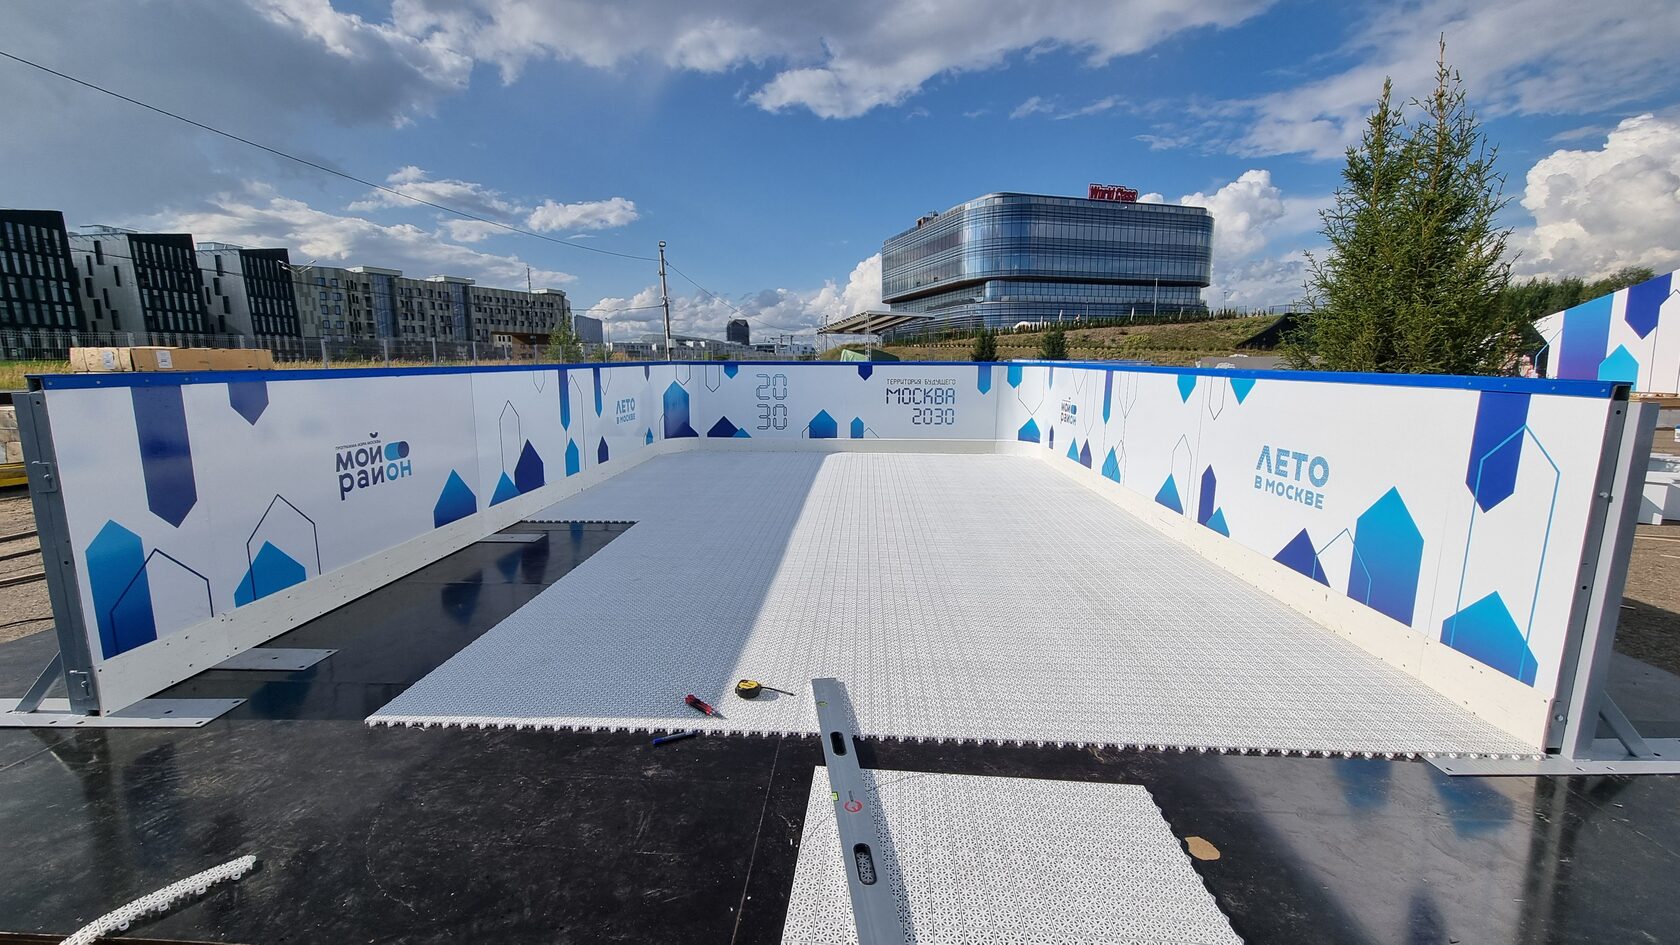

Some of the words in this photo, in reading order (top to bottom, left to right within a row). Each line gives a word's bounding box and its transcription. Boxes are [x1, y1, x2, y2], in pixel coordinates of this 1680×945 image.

[1090, 186, 1116, 200] World
[1116, 188, 1137, 202] Class
[756, 373, 788, 400] 20
[924, 378, 956, 386] БУДУЩЕГО
[886, 387, 955, 405] МОСКВА
[616, 397, 636, 415] ЛЕТО
[756, 403, 788, 430] 30
[912, 407, 954, 425] 2030
[1256, 445, 1329, 488] ЛЕТО
[1254, 475, 1262, 490] В
[1265, 478, 1325, 510] МОСКВЕ
